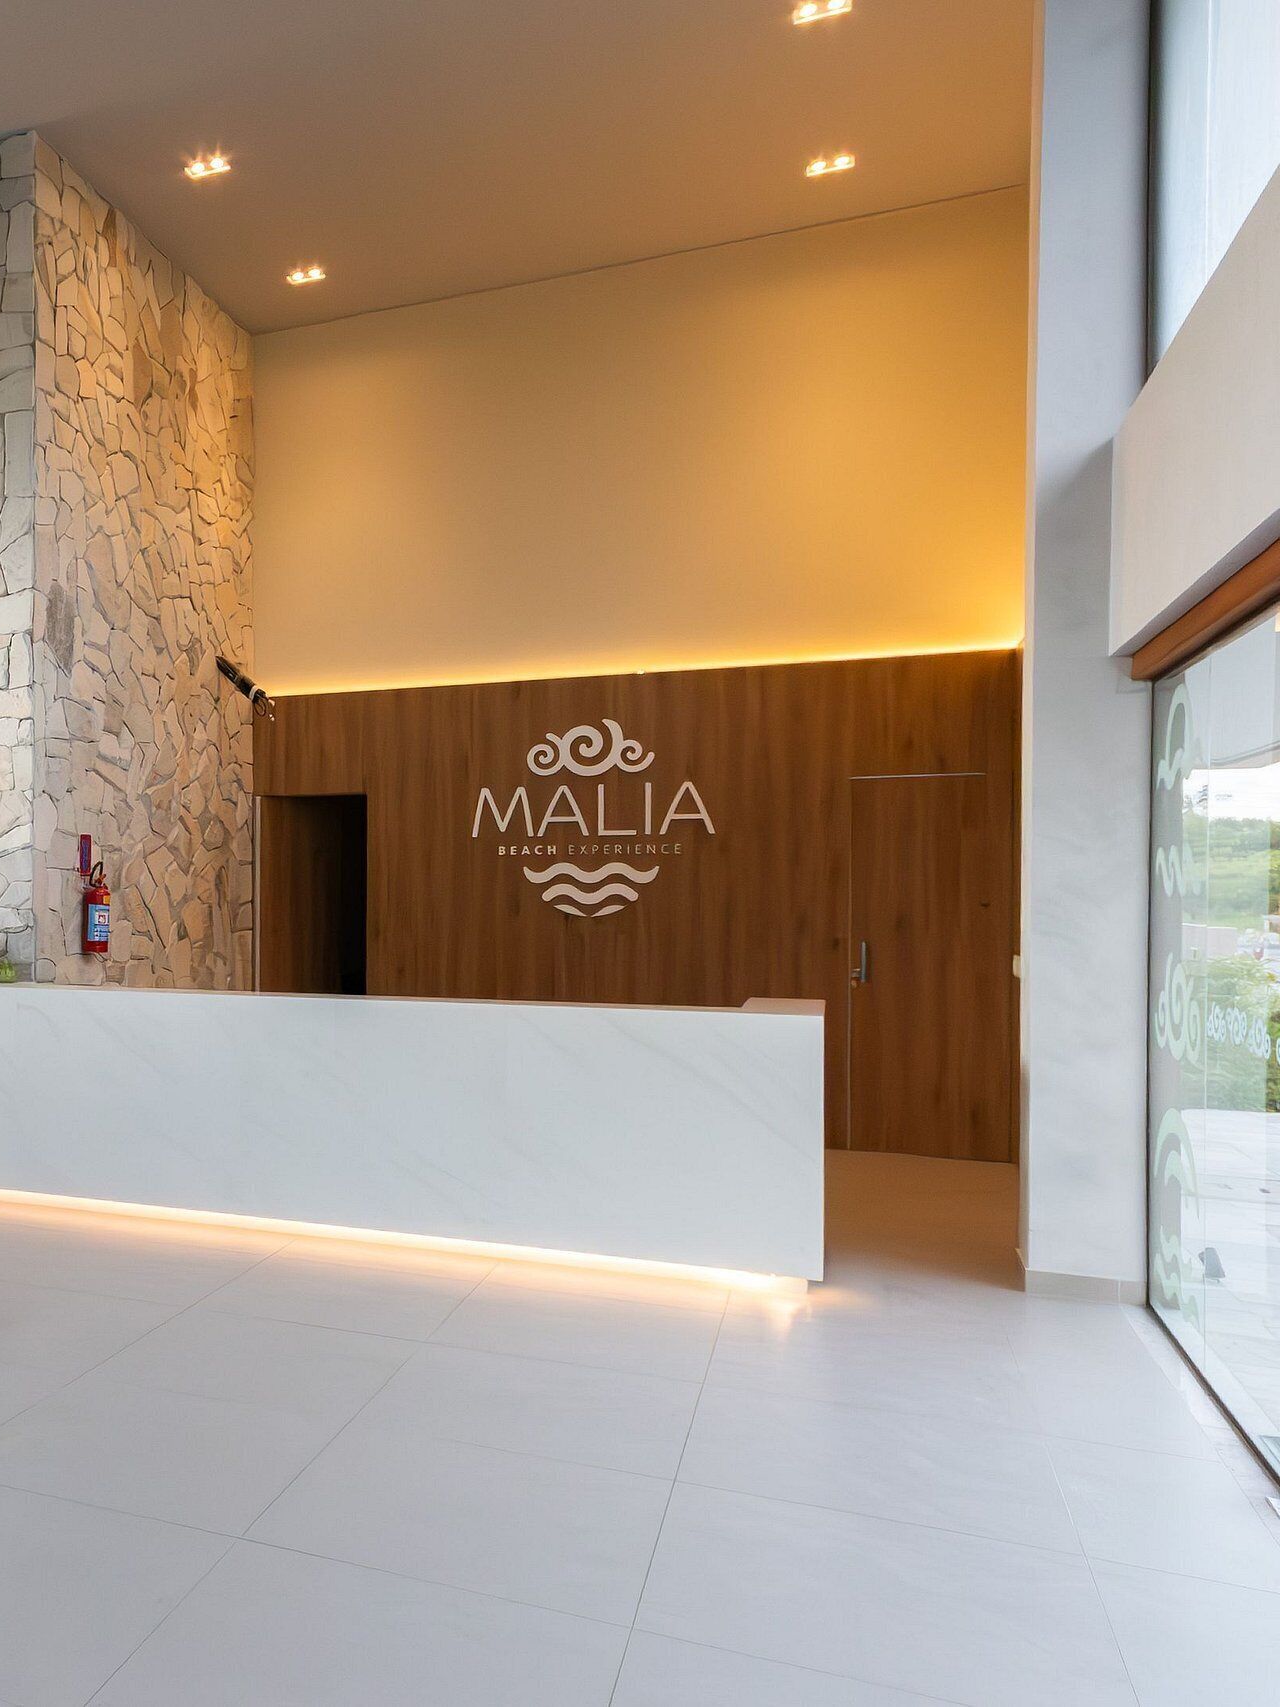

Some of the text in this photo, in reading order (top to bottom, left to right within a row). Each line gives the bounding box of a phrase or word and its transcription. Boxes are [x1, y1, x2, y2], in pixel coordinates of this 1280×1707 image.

[472, 781, 716, 838] MALIA
[498, 843, 682, 856] BEACH EXPERIENCE
